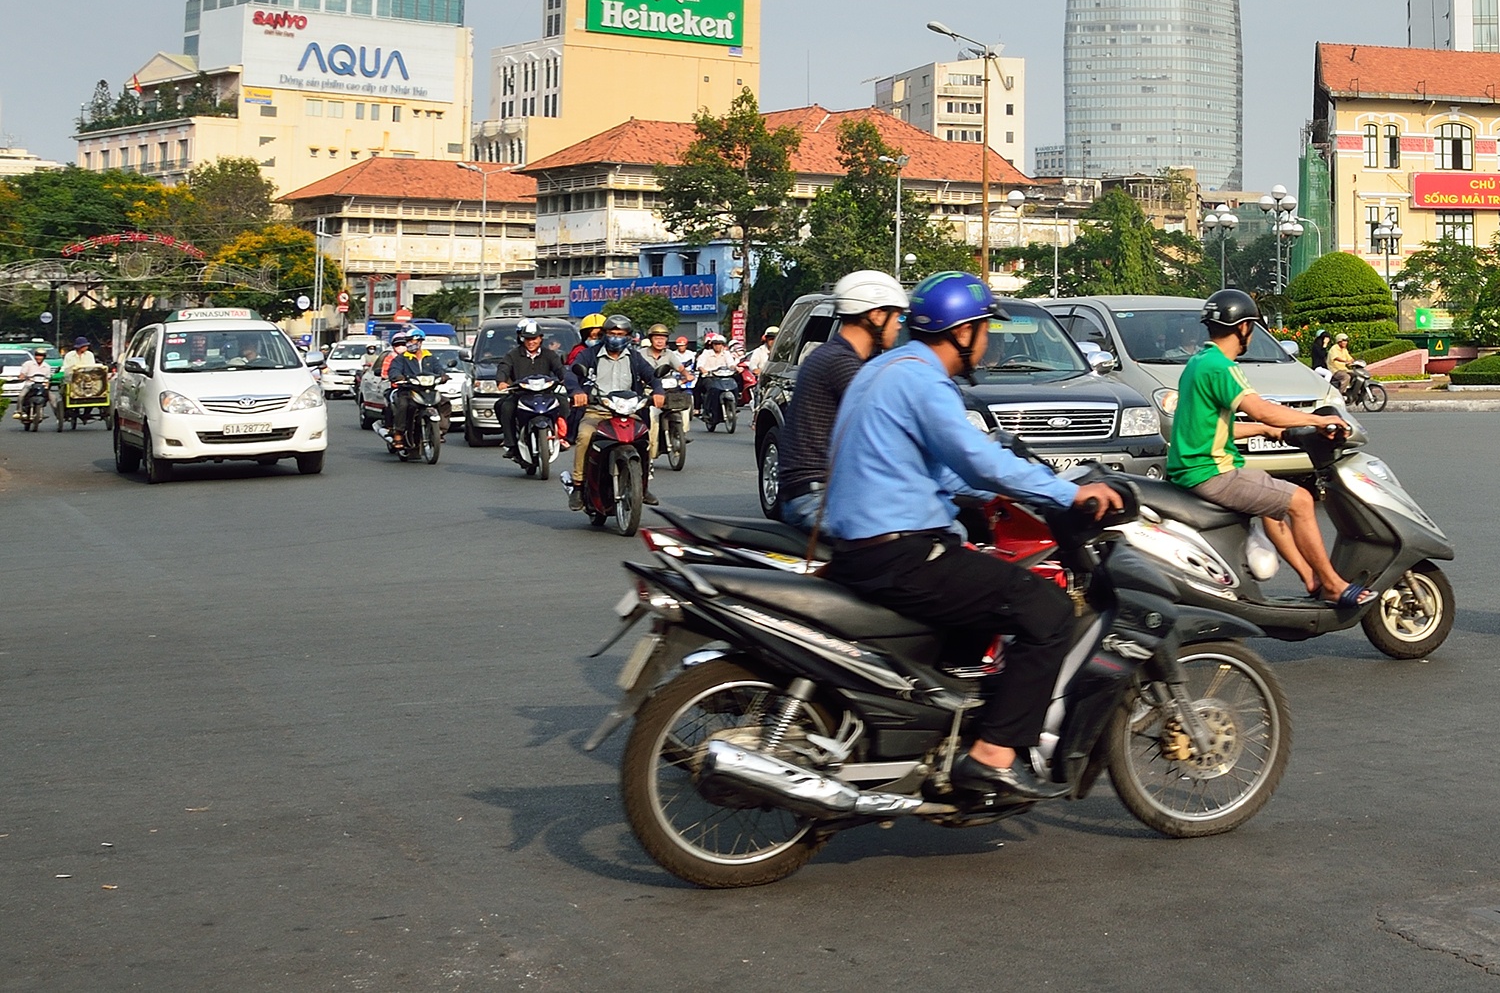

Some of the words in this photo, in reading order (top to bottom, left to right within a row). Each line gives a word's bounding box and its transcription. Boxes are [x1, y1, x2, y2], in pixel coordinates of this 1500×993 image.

[252, 10, 308, 30] SANYO
[601, 0, 734, 40] Heineken
[297, 42, 410, 81] AQUA
[346, 82, 360, 91] cao
[1469, 177, 1496, 190] CHỦ
[1424, 192, 1458, 204] SỐNG
[1461, 193, 1485, 205] MÃI
[570, 284, 590, 303] CỬA
[591, 283, 619, 303] HÀNG
[672, 280, 690, 300] SÀI
[691, 281, 715, 299] GÒN
